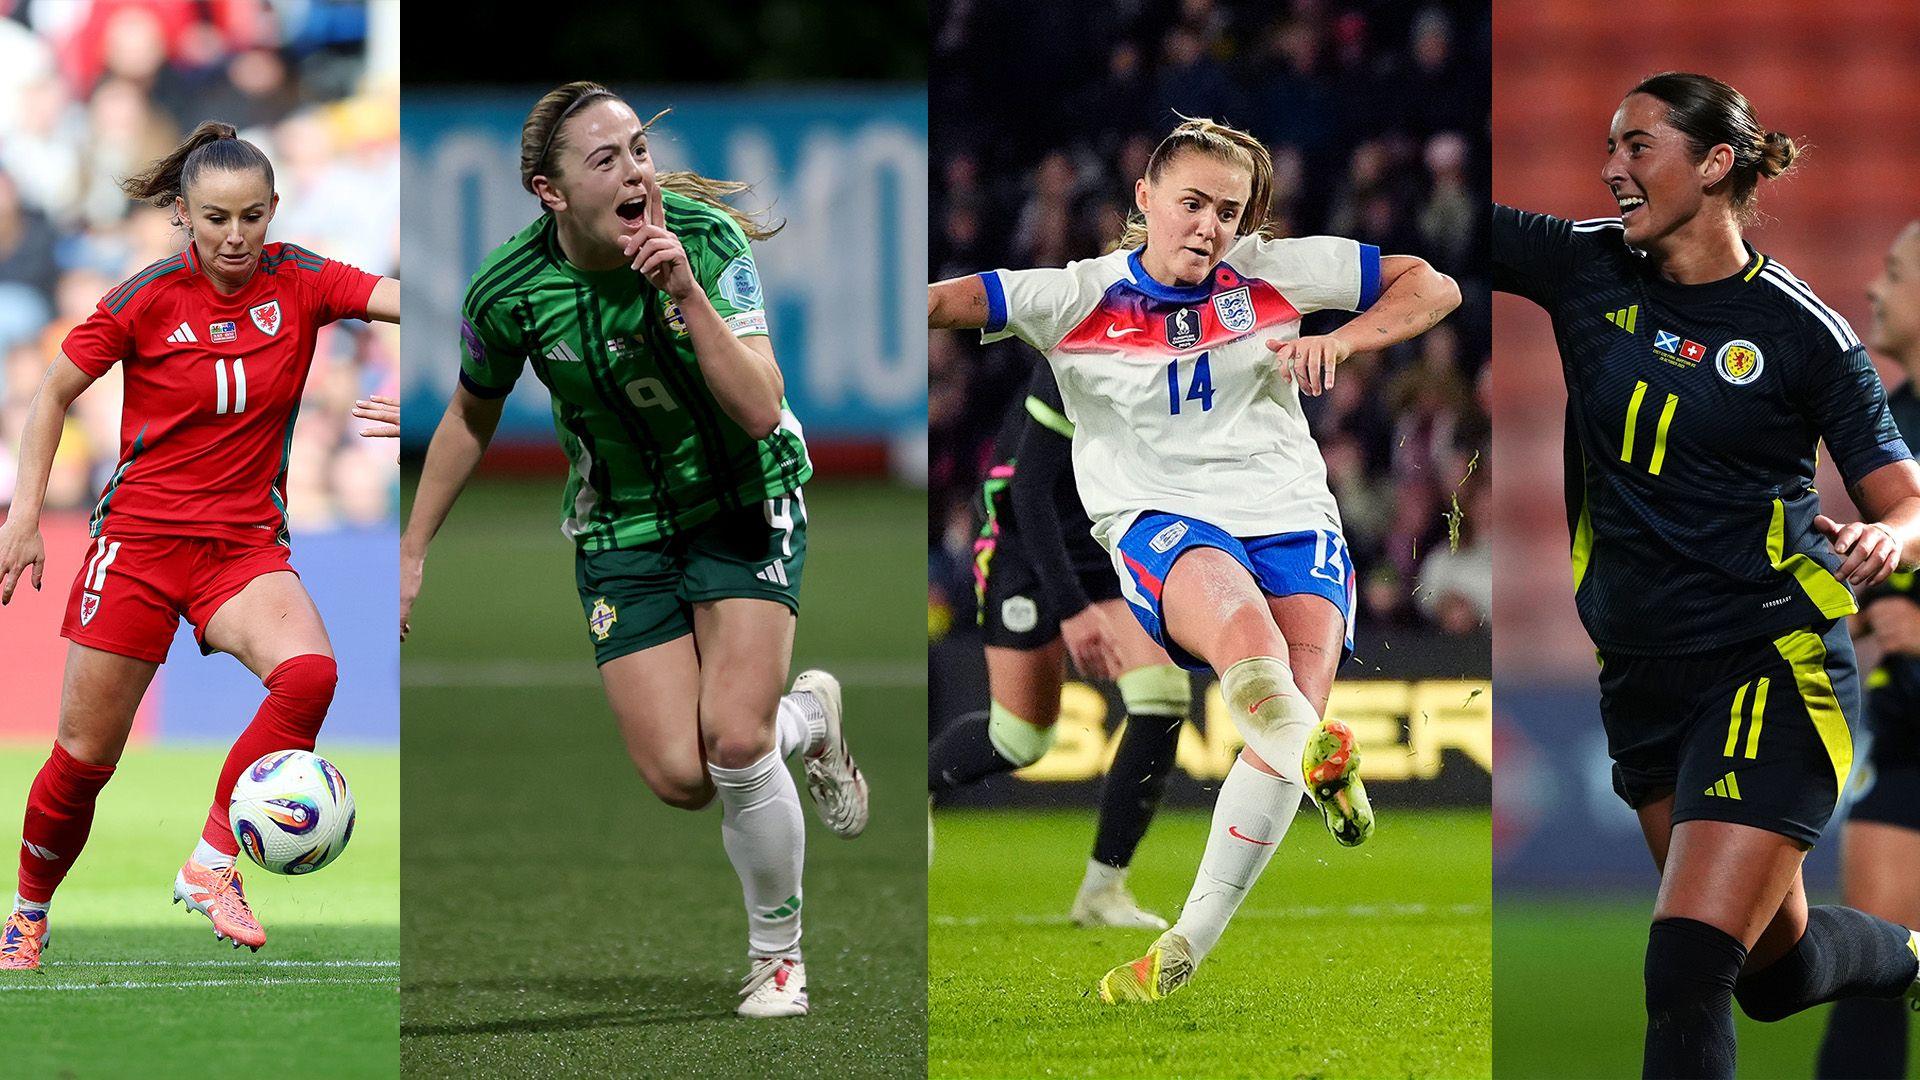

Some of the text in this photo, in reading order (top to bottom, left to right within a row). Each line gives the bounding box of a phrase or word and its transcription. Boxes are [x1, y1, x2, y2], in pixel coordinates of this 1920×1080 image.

[215, 357, 247, 415] 11
[624, 376, 679, 412] 9
[1167, 351, 1217, 416] 14
[1620, 380, 1679, 476] 11
[84, 535, 122, 592] 11
[1723, 677, 1770, 760] 11
